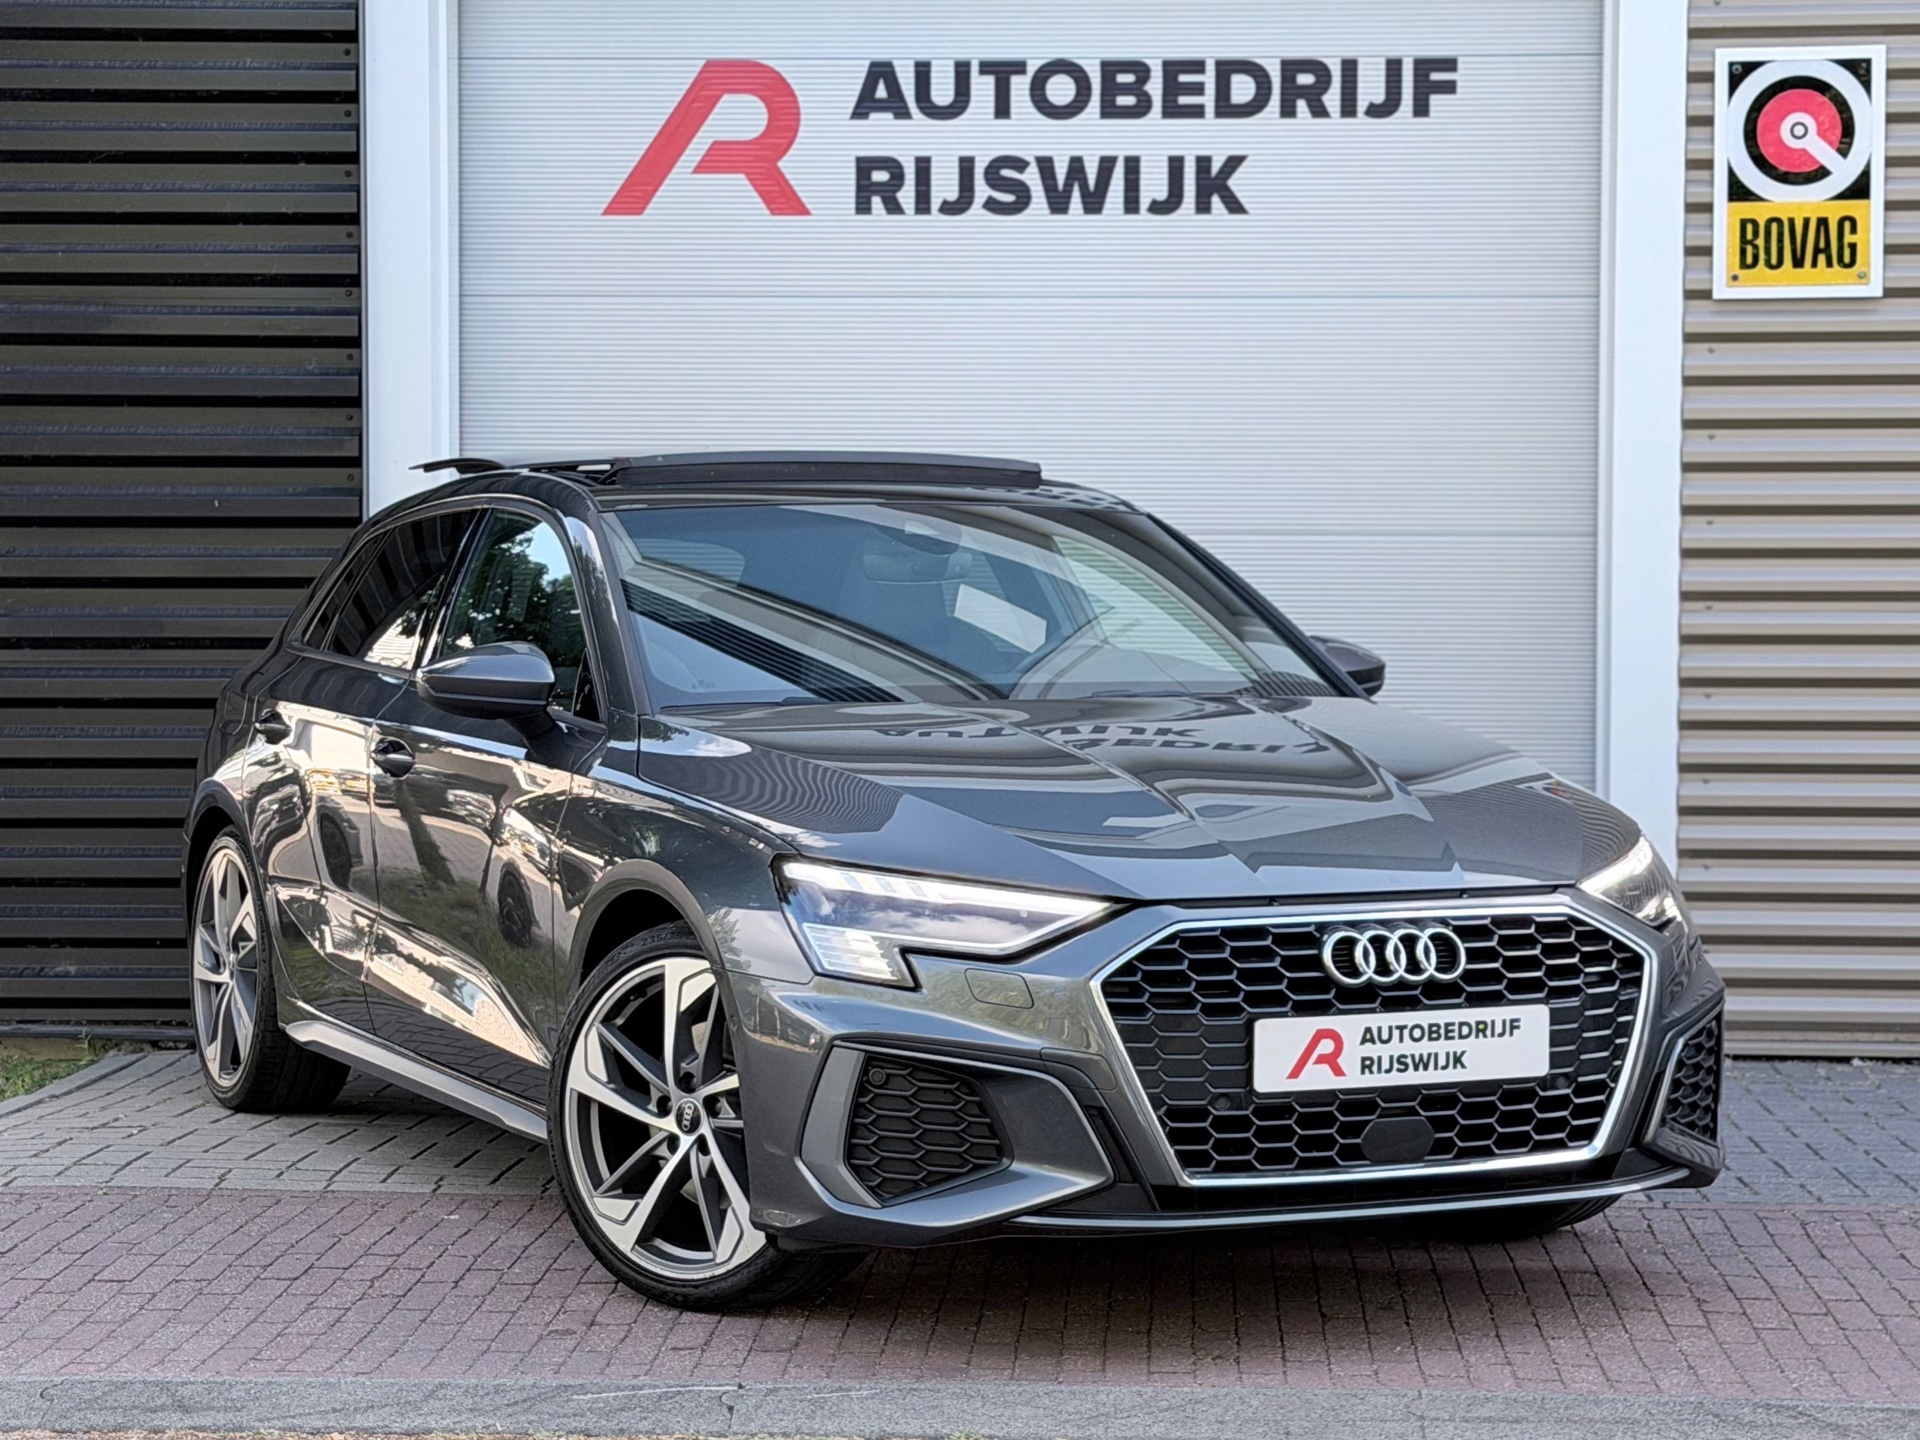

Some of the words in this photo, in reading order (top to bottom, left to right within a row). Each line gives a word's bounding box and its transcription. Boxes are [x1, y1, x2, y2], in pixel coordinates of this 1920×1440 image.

[850, 57, 1458, 121] AUTOBEDRIJF
[855, 155, 1248, 216] RIJSWIJK
[1739, 215, 1858, 270] BOVAG
[1359, 1017, 1522, 1046] AUTOBEDRIJF
[1360, 1050, 1468, 1076] RIJSWIJK
